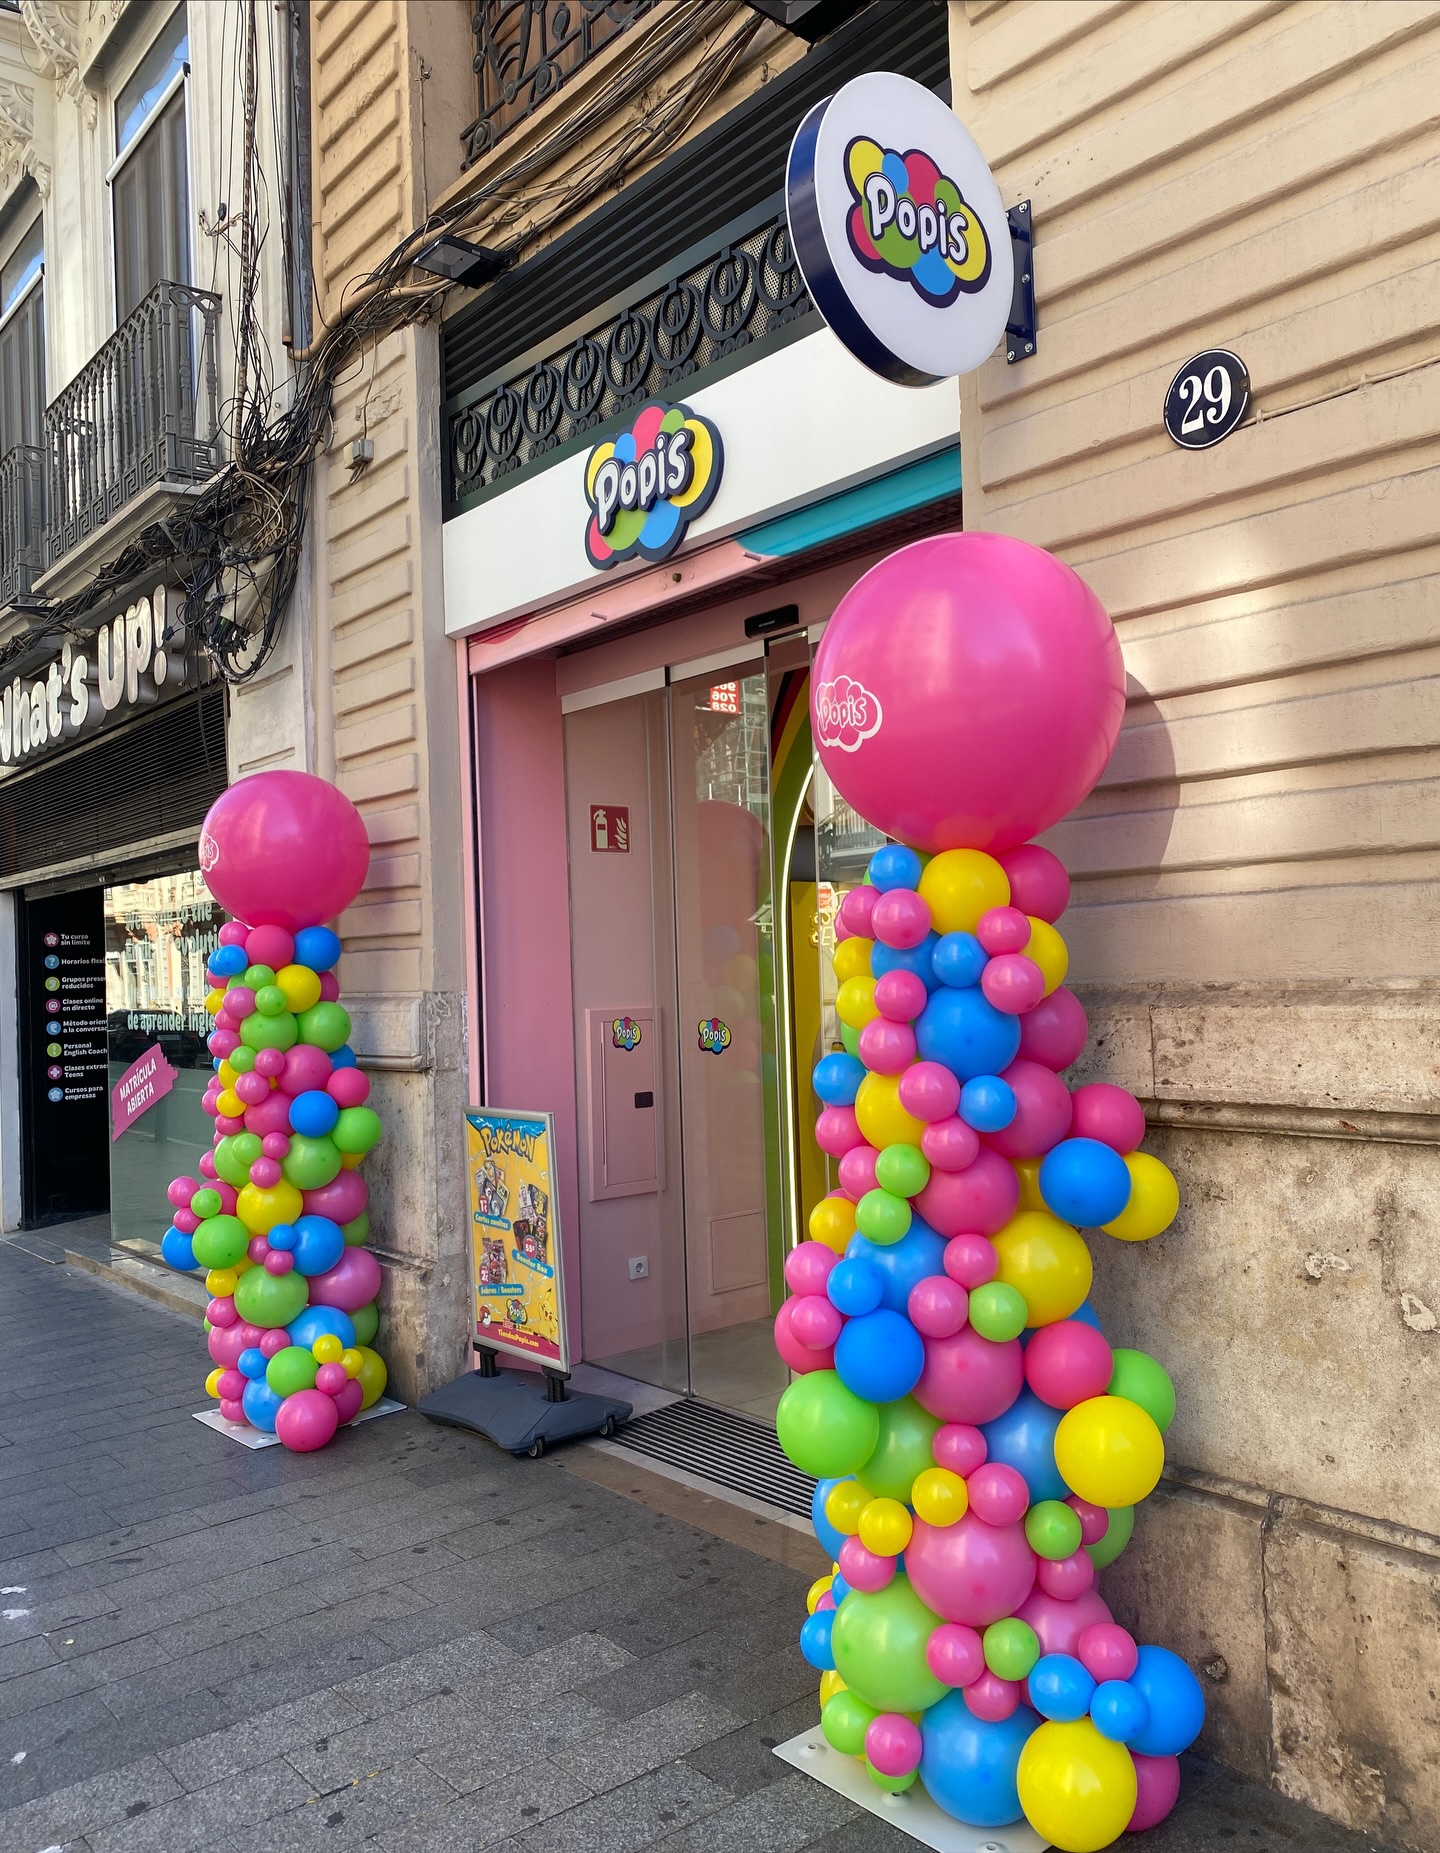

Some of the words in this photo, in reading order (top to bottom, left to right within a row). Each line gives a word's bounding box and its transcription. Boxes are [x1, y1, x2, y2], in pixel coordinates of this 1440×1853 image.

[864, 172, 968, 263] Popis
[1179, 366, 1232, 435] 29
[593, 429, 692, 532] Popis
[820, 695, 867, 732] Popis
[61, 982, 94, 990] reducidos
[127, 1009, 140, 1031] de
[616, 1026, 637, 1041] Popis
[702, 1028, 726, 1043] Popis
[63, 1042, 92, 1050] Personal
[63, 1049, 87, 1057] English
[88, 1085, 104, 1093] para
[119, 1058, 157, 1102] MATRÍCULA
[64, 1093, 97, 1101] empresas
[127, 1081, 155, 1116] ABIERTA
